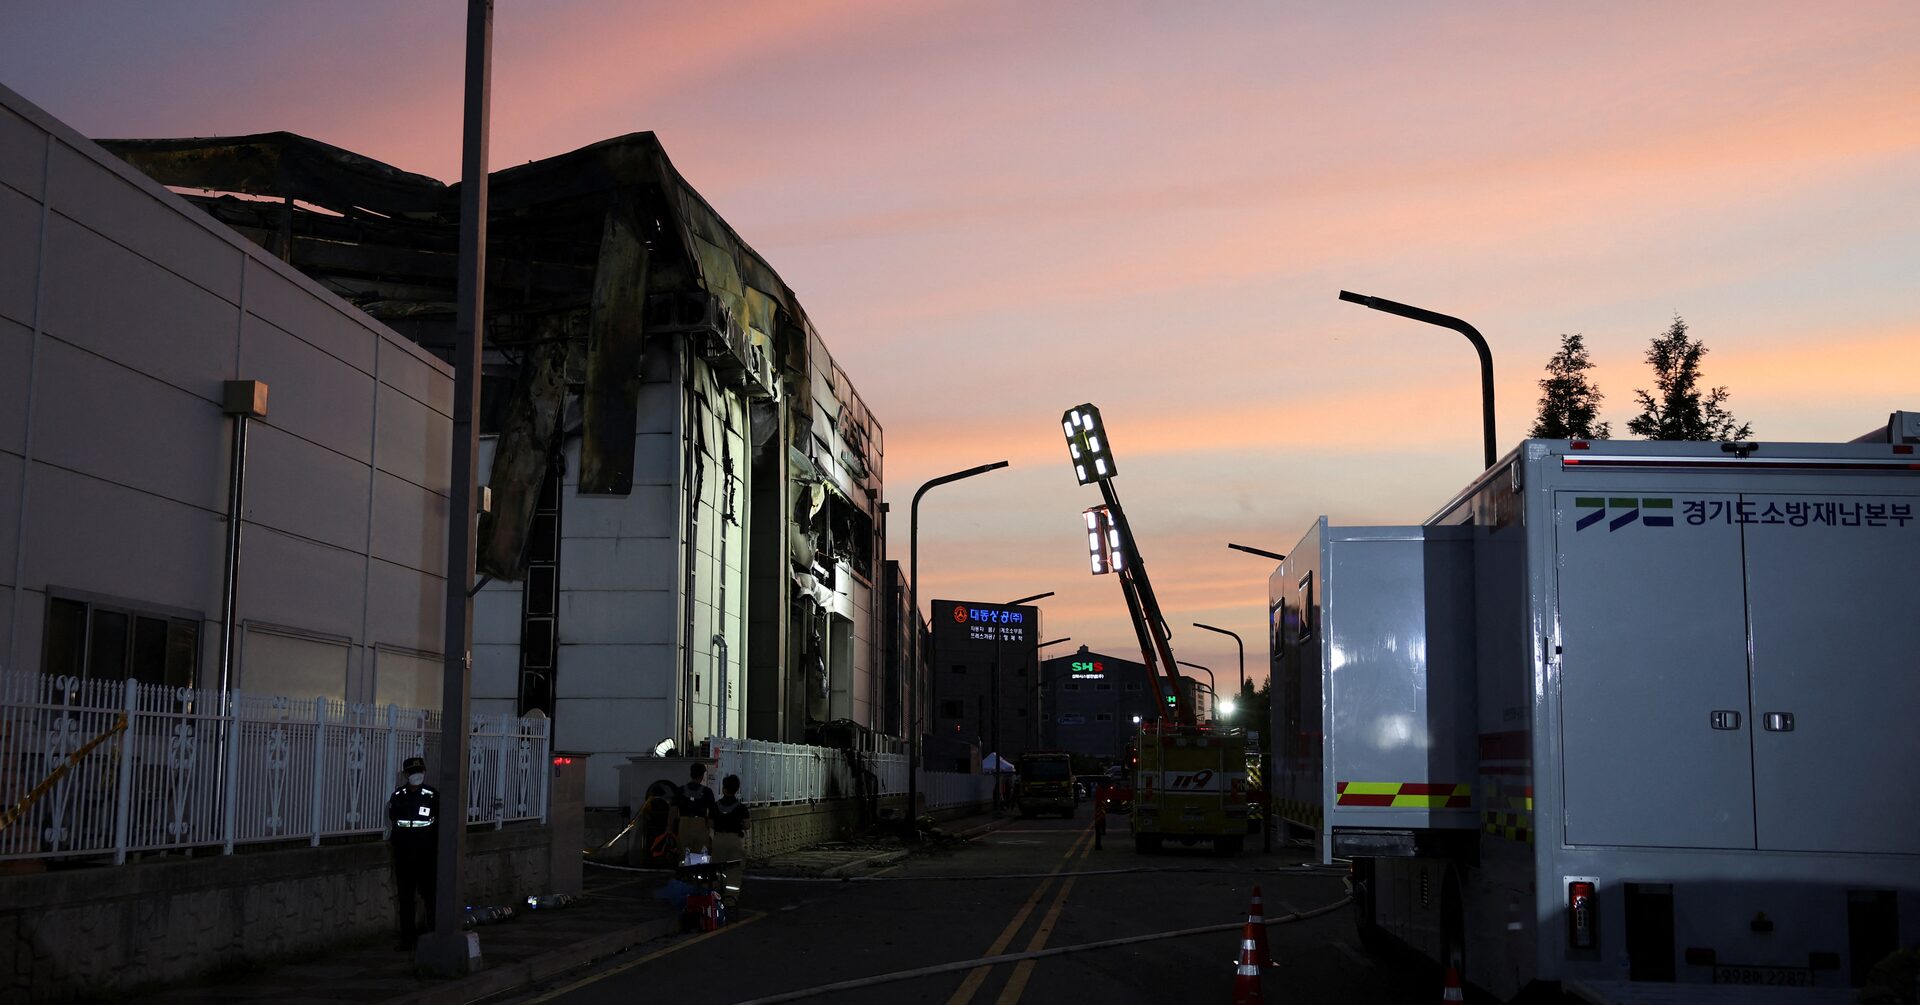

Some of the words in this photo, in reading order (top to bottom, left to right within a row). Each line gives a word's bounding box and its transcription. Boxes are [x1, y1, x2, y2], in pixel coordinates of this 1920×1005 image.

[1682, 500, 1913, 527] 경기도소방재난본부
[1071, 662, 1104, 673] SHS
[1172, 769, 1213, 788] 119
